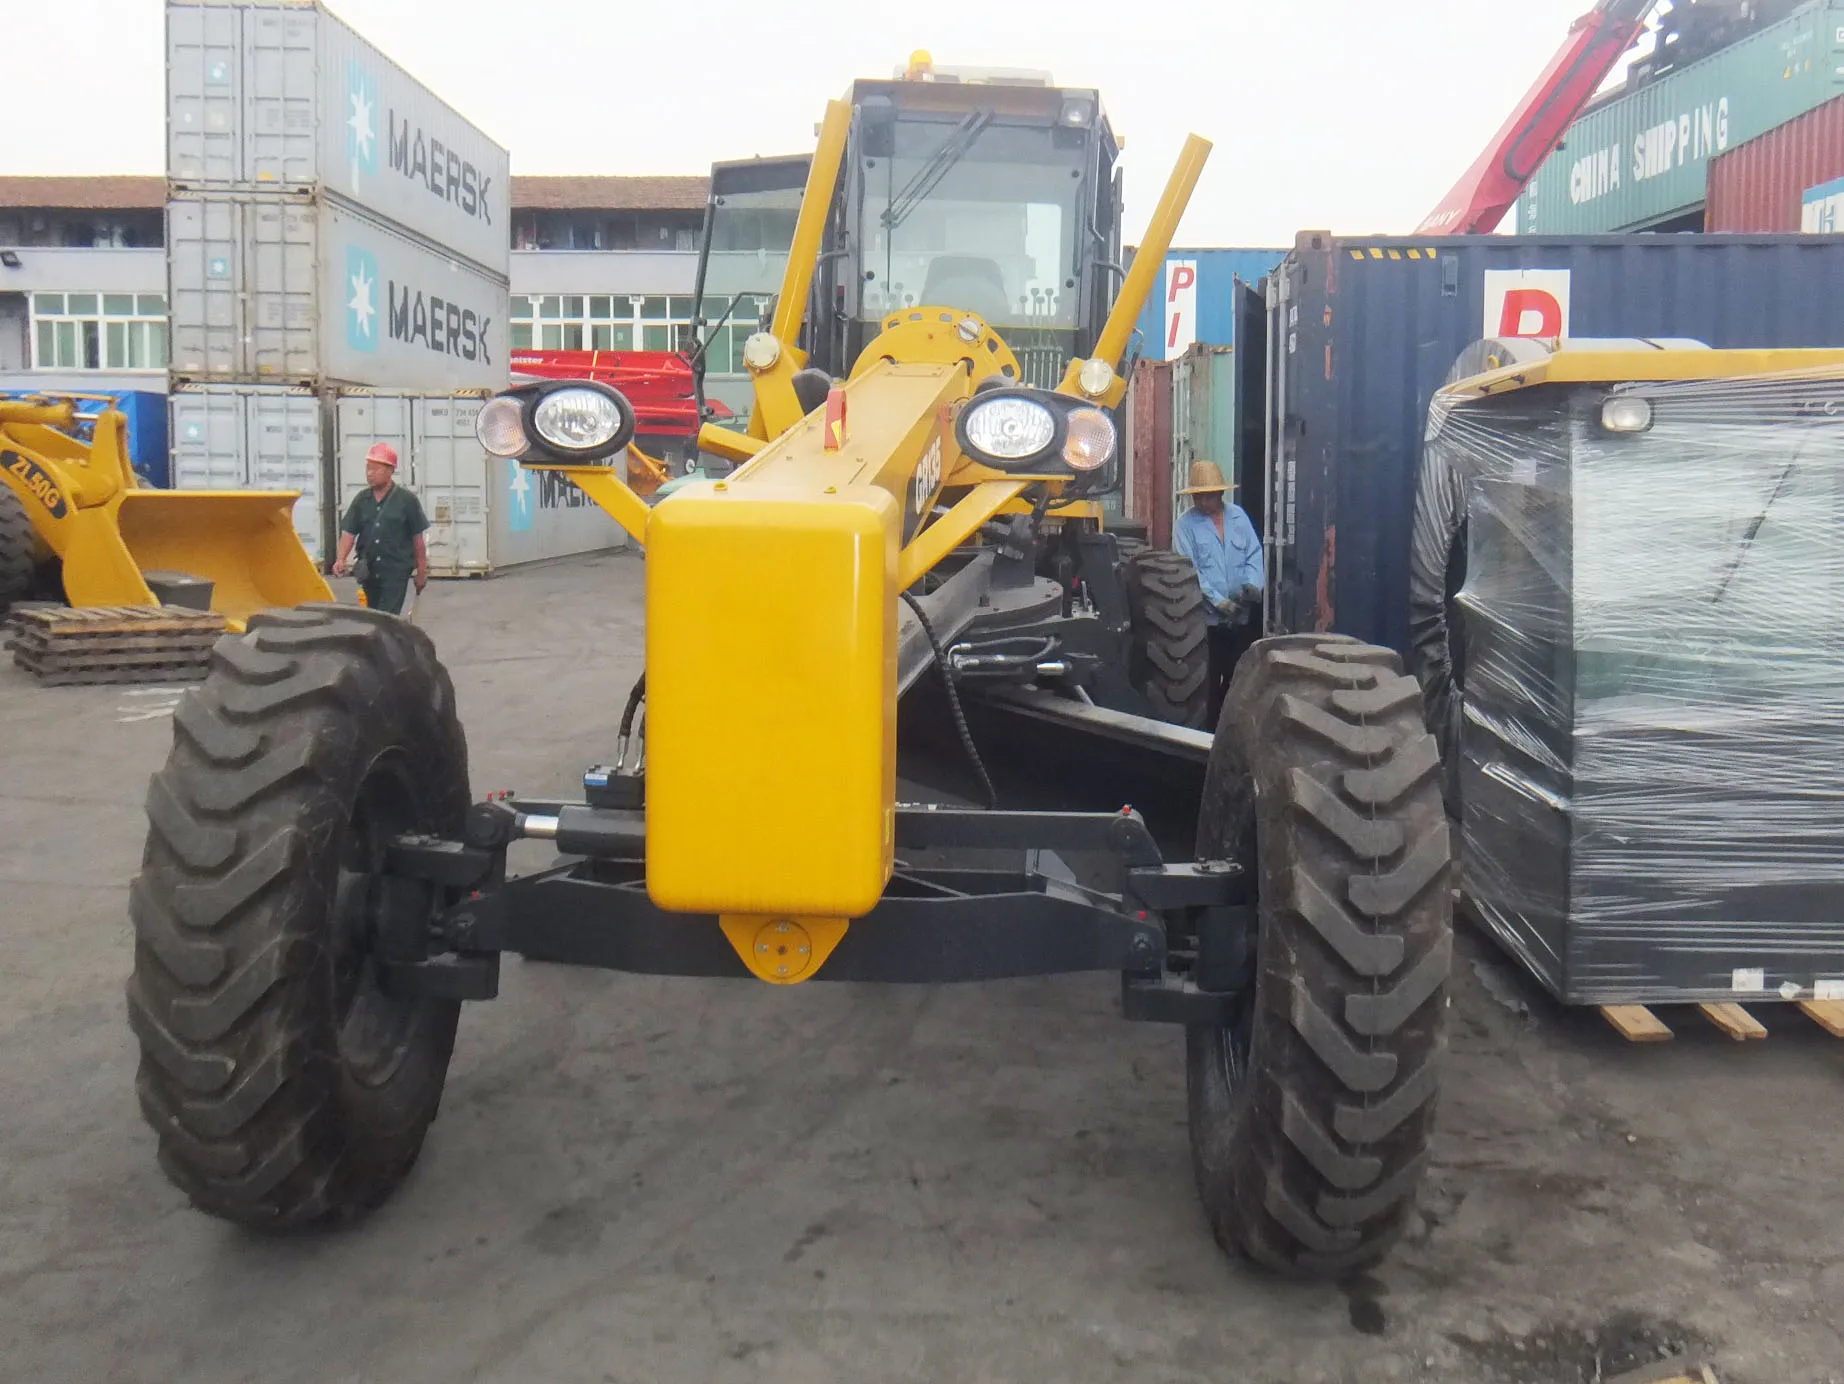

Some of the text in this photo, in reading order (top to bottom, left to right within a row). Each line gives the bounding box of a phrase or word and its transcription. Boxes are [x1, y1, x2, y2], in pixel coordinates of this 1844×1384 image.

[388, 108, 492, 226] MAERSK
[1570, 97, 1728, 205] CHINA SHIPPING
[388, 280, 491, 366] MAERSK
[9, 455, 60, 508] ZL50G
